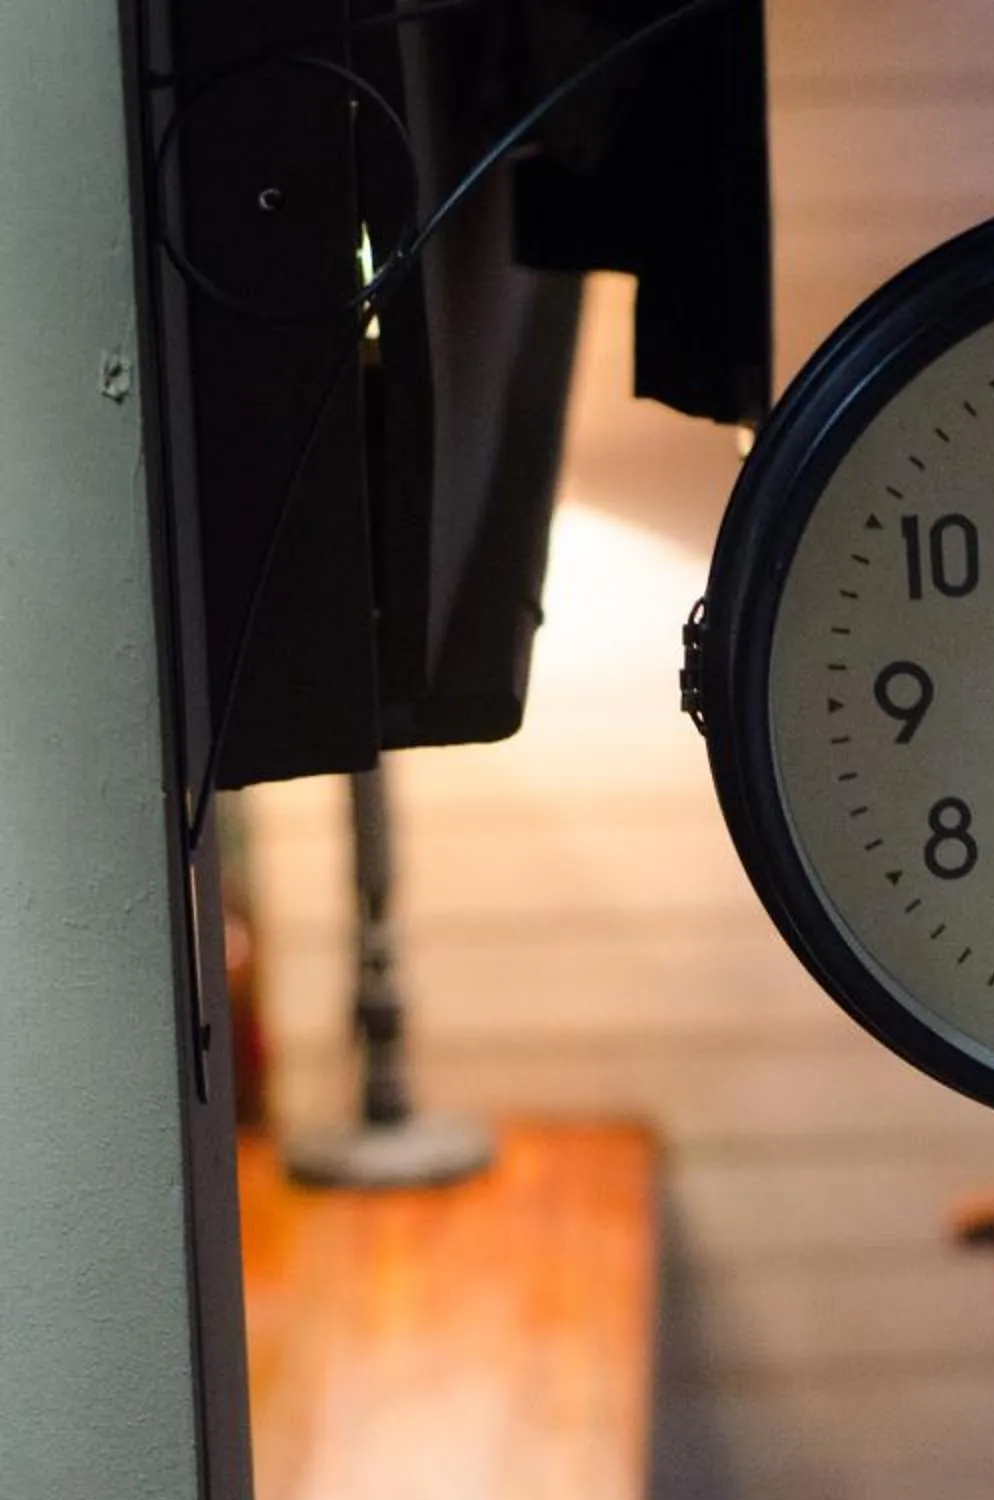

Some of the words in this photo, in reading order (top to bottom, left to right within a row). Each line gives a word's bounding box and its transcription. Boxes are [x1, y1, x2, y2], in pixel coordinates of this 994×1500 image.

[900, 513, 980, 601] 10
[872, 661, 935, 745] 9
[923, 797, 979, 881] 8
